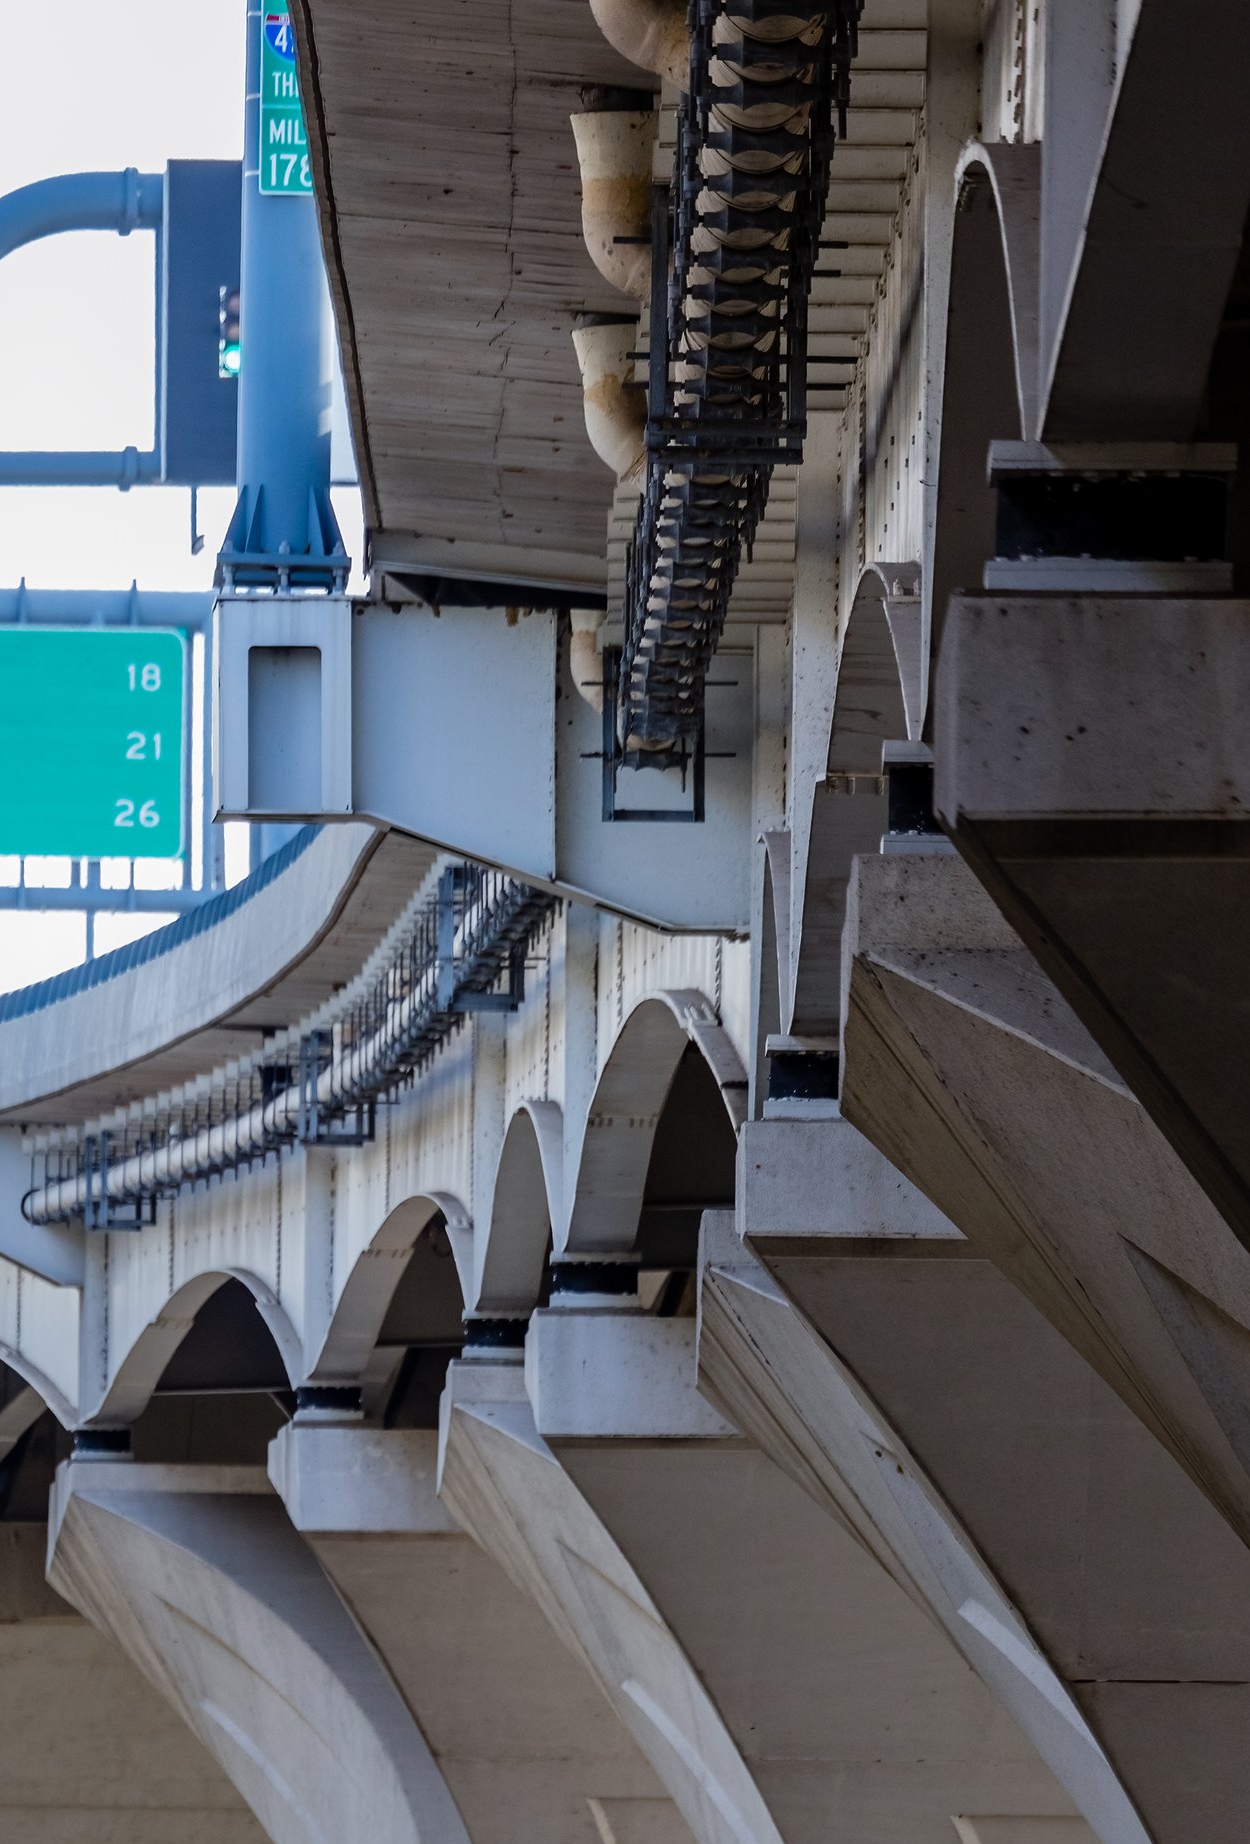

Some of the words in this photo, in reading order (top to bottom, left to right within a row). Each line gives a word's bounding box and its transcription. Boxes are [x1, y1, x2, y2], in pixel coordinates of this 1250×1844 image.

[269, 118, 307, 145] MIL
[127, 662, 161, 692] 18
[125, 730, 162, 761] 21
[114, 798, 161, 829] 26
